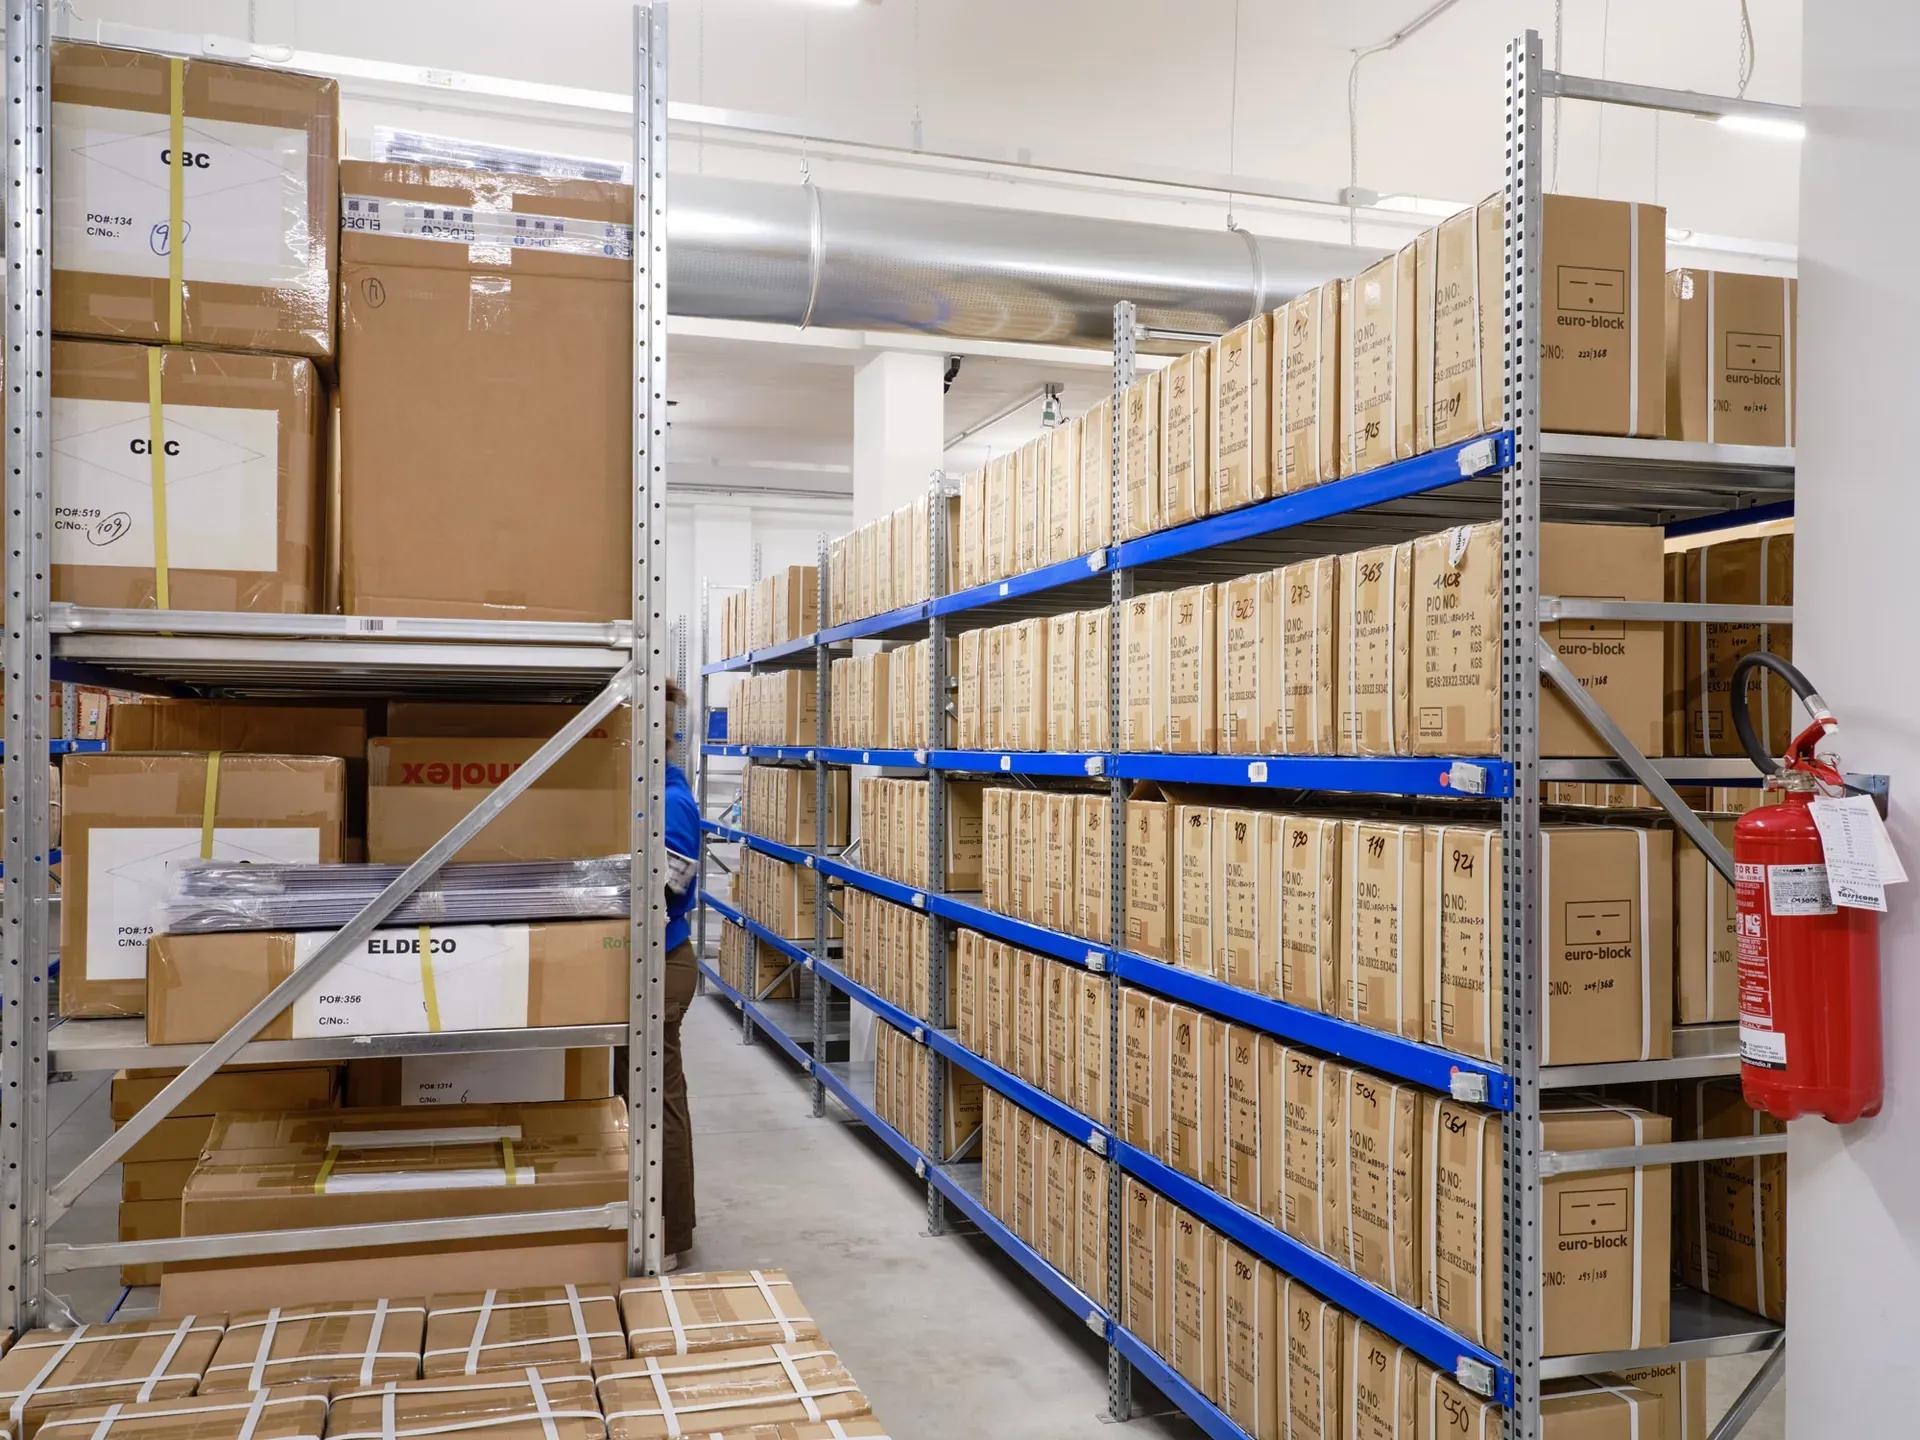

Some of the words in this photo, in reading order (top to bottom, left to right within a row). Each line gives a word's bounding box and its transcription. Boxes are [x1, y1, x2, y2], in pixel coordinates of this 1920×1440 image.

[86, 213, 132, 226] PO#:134
[339, 216, 381, 231] ELDEC
[86, 227, 120, 238] C/No.:
[1557, 314, 1625, 331] euro-block
[1725, 373, 1782, 387] euro-block
[55, 507, 101, 518] PO#:519
[54, 521, 88, 531] C/No.:
[1426, 596, 1441, 613] P/O
[1443, 593, 1459, 609] NO:
[1470, 624, 1482, 637] PCS
[1470, 640, 1482, 653] KGS
[1558, 642, 1626, 656] euro-block
[1470, 656, 1483, 669] KGS
[1366, 884, 1380, 900] NO:
[1451, 894, 1468, 911] NO:
[118, 926, 154, 936] PO#:13
[367, 938, 457, 954] ELDECO
[1565, 946, 1632, 962] euro-block
[319, 995, 362, 1005] PO#:356
[319, 1016, 350, 1026] C/No.:
[1292, 1059, 1313, 1078] 372
[1294, 1104, 1307, 1121] NO:
[1361, 1133, 1376, 1154] NO:
[1447, 1170, 1462, 1191] NO:
[1558, 1234, 1628, 1251] euro-block
[1625, 1364, 1677, 1383] euro-block
[1367, 1392, 1380, 1410] NO:
